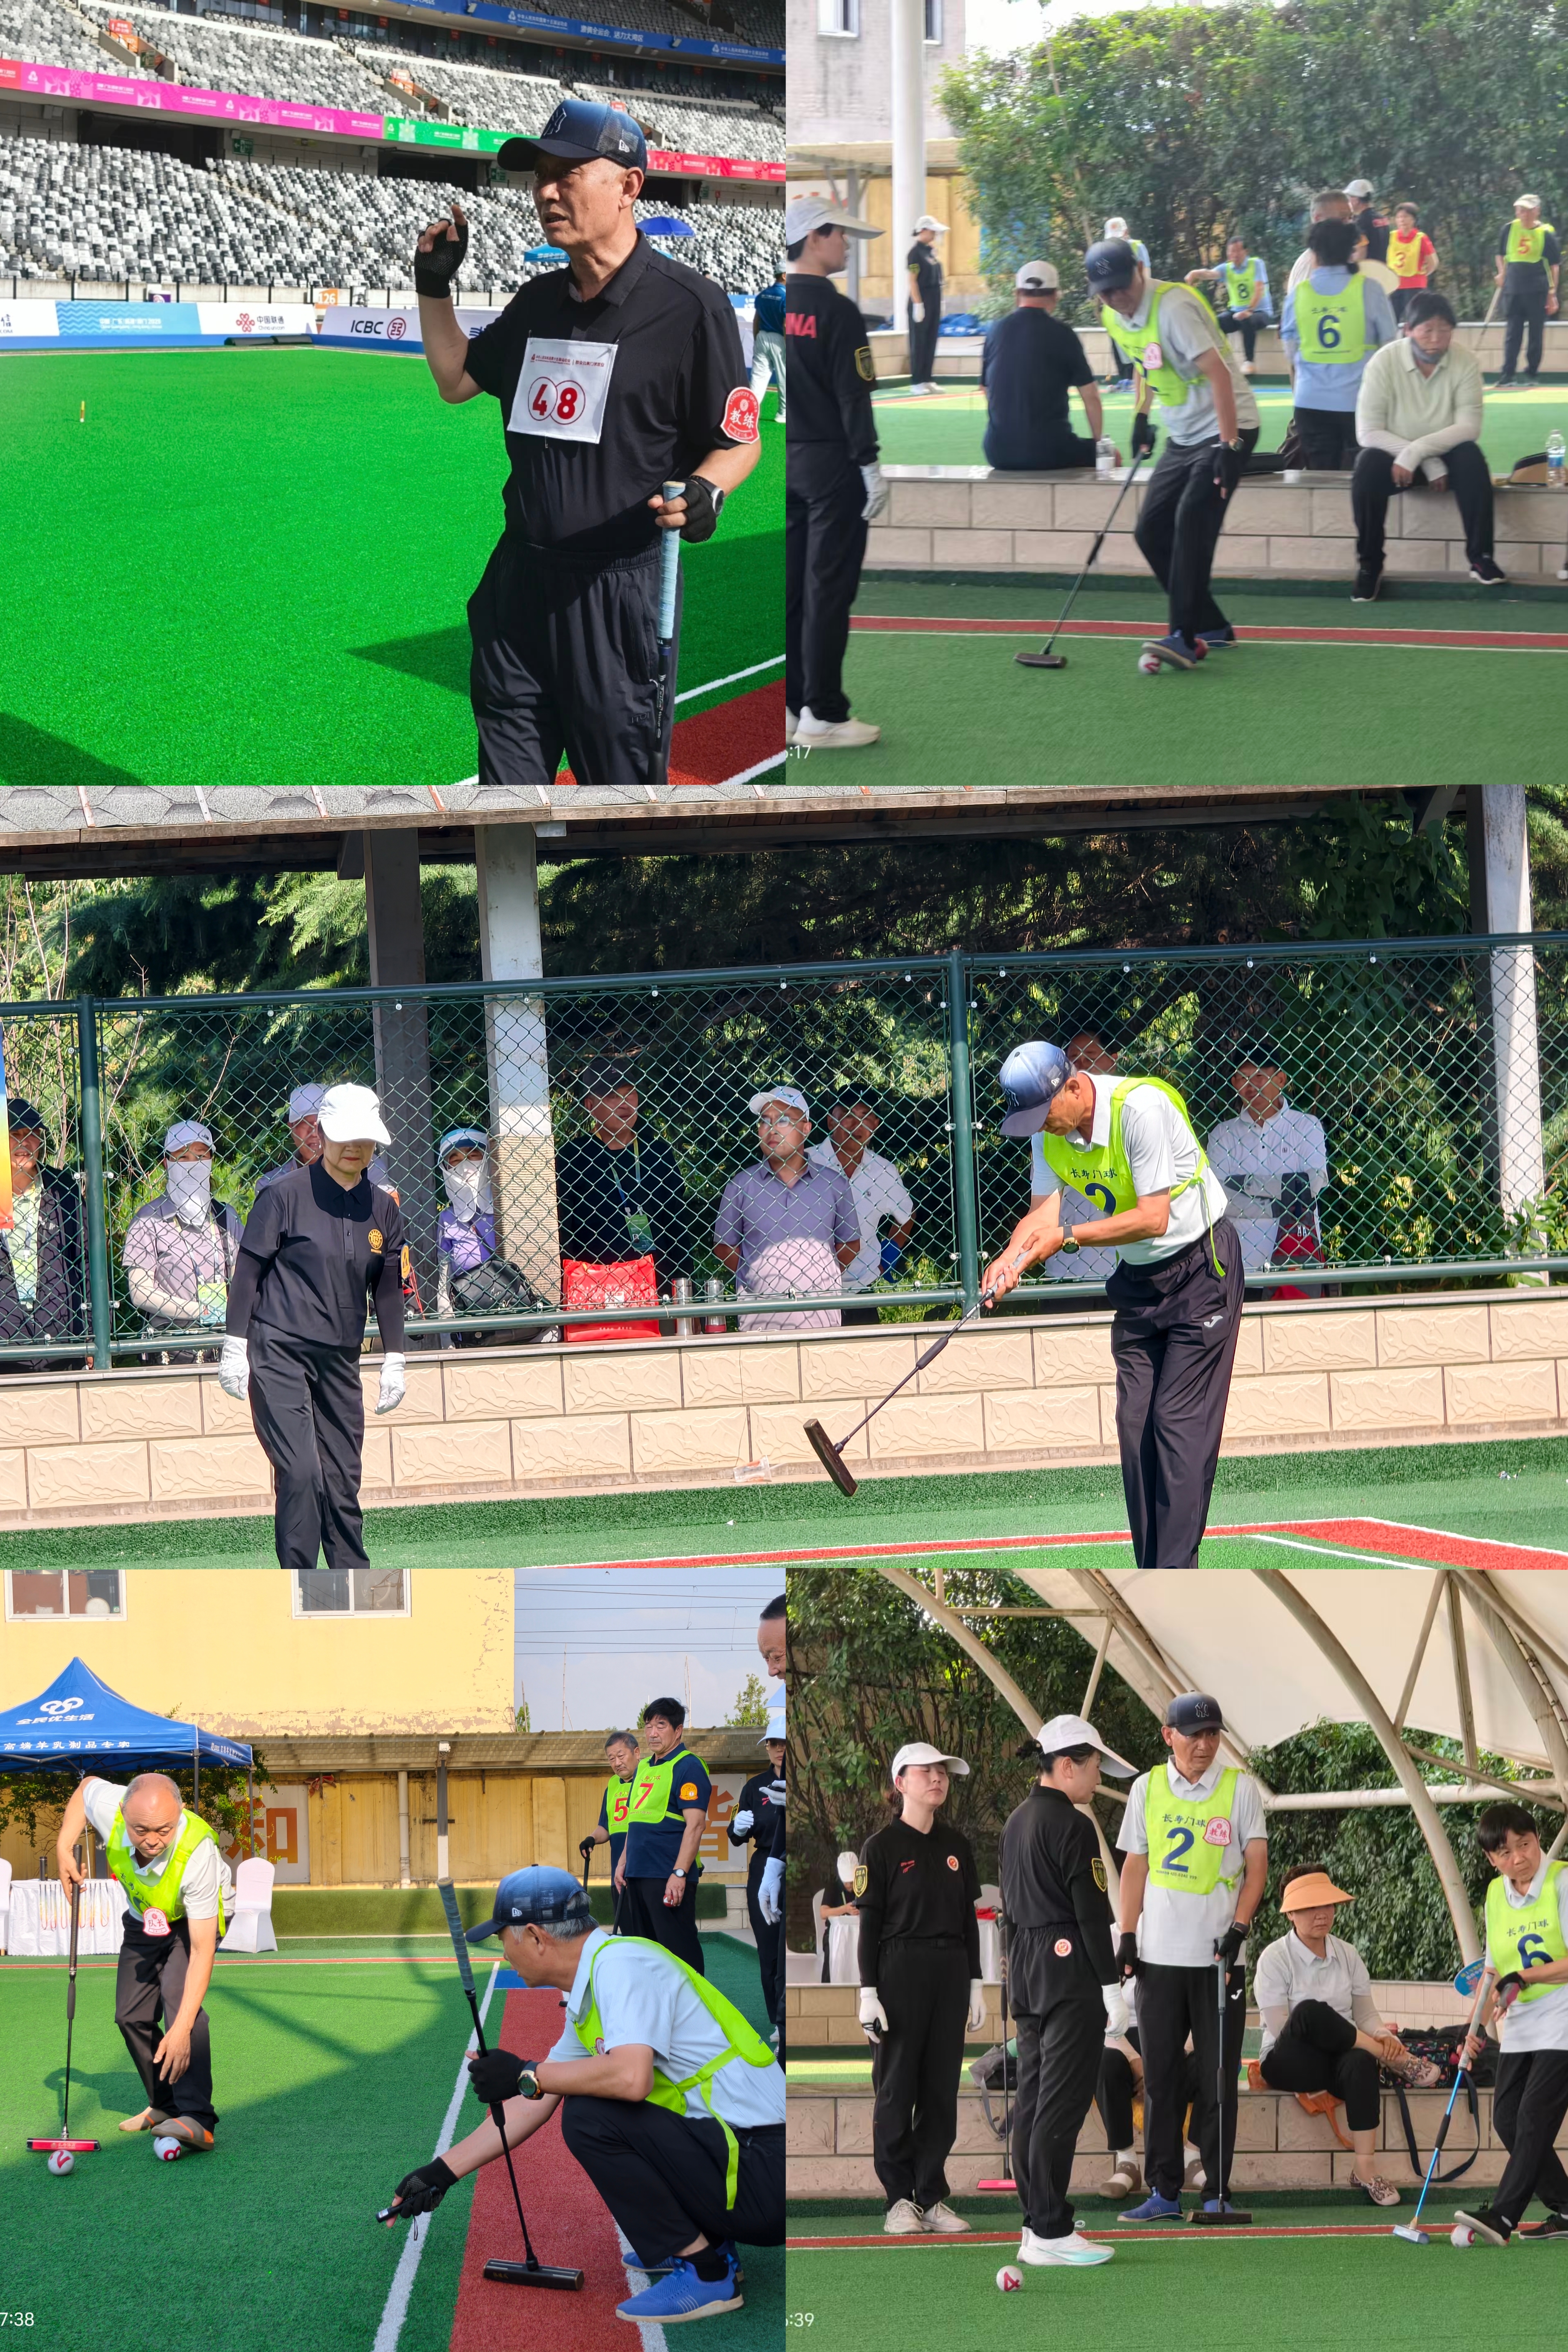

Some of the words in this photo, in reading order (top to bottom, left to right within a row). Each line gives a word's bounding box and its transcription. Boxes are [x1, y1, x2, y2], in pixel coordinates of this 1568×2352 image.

[319, 293, 336, 305] 126
[1237, 283, 1250, 299] 8
[257, 316, 284, 324] 中国联通
[350, 320, 383, 334] ICBC
[1318, 315, 1341, 348] 6
[532, 384, 578, 419] 48
[729, 408, 754, 429] 教练
[1071, 1167, 1117, 1180] 长寿门球
[16, 1714, 95, 1724] 全民优生活
[4, 1740, 130, 1750] 高端羊乳制品专家
[634, 1783, 654, 1809] 7
[614, 1797, 628, 1822] 5
[1162, 1814, 1206, 1828] 长寿门球
[1162, 1827, 1194, 1873] 2
[1507, 1919, 1549, 1937] 长寿门球
[1517, 1933, 1554, 1969] 6
[1004, 2271, 1020, 2292] 4
